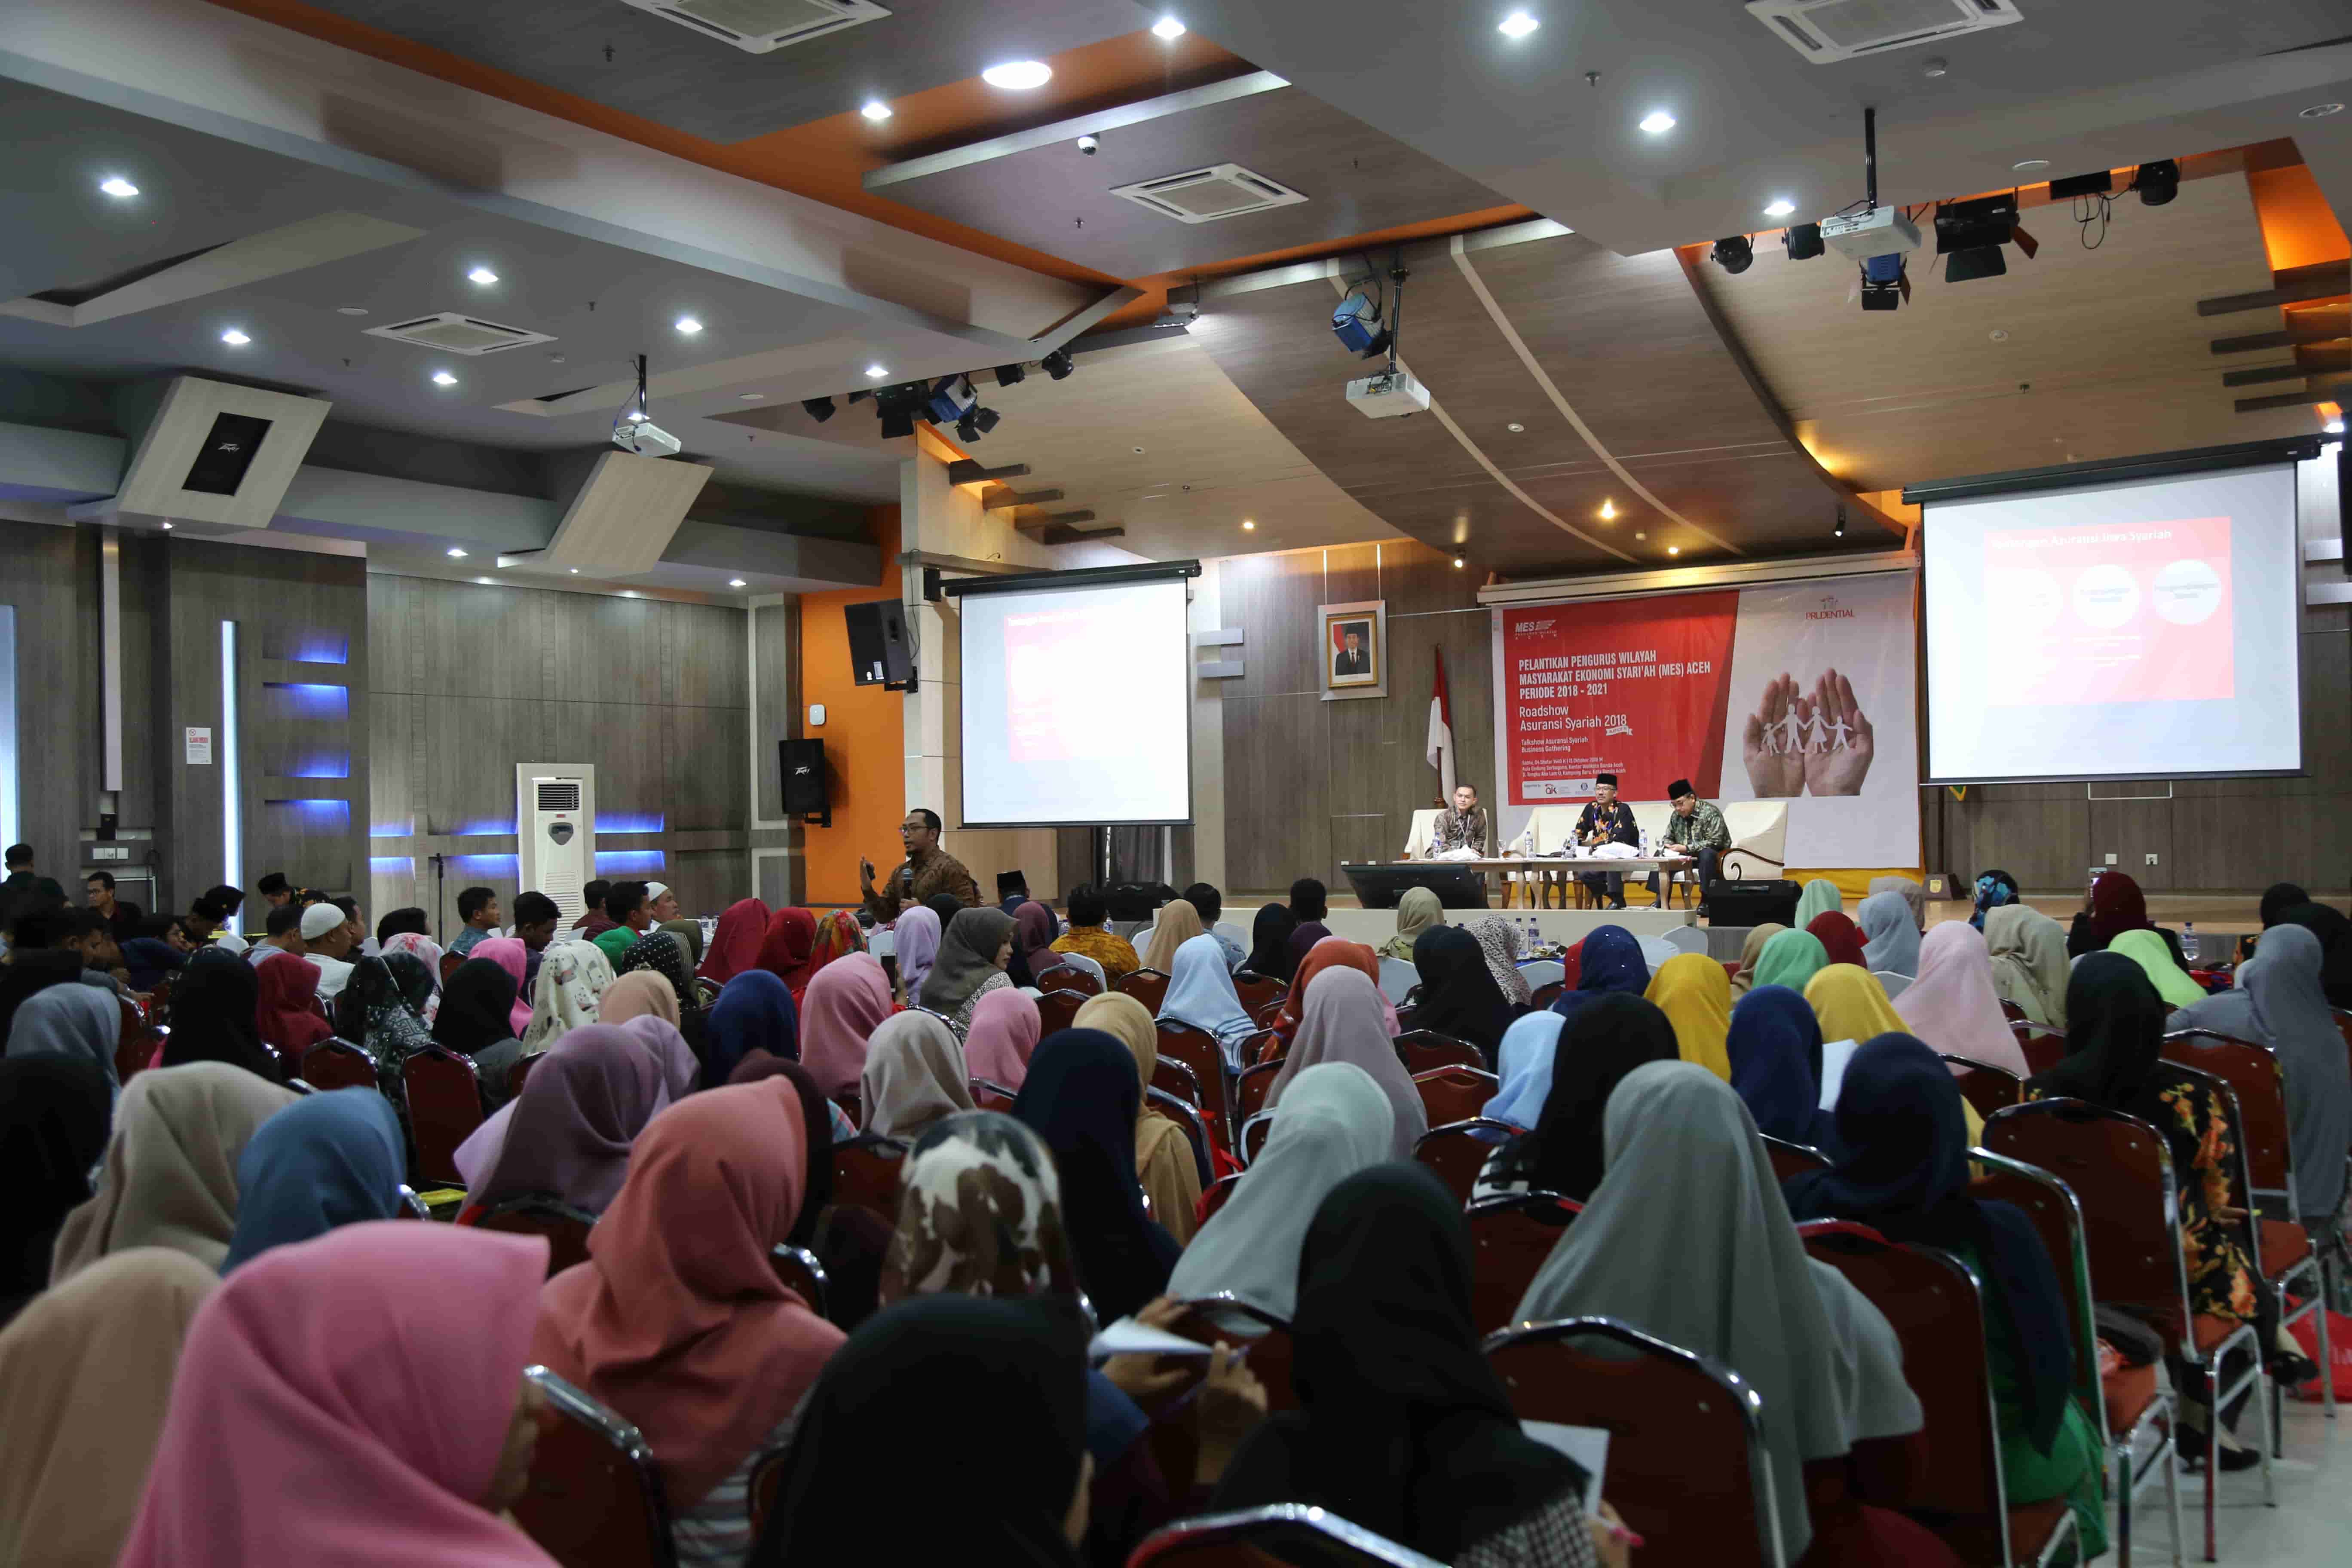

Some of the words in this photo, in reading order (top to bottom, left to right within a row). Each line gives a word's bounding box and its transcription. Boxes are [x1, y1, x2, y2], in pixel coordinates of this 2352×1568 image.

[1805, 609, 1855, 619] PRUDENTIAL
[1516, 622, 1534, 633] MES
[1519, 656, 1568, 671] PELANTIKAN
[1571, 653, 1616, 667] PENGURUS
[1619, 650, 1656, 664] WILAYAH
[1519, 671, 1573, 685] MASYARAKAT
[1575, 667, 1614, 681] EKONOMI
[1617, 665, 1656, 679] SYARI'AH
[1659, 663, 1684, 679] (MES)
[1687, 661, 1711, 674] ACEH
[1520, 686, 1555, 700] PERIODE
[1557, 685, 1578, 697] 2018
[1587, 683, 1607, 695] 2021
[1519, 705, 1568, 718] Roadshow
[1520, 718, 1562, 731] Asuransi
[1565, 716, 1601, 731] Syariah
[1605, 714, 1627, 726] 2018
[1569, 736, 1588, 745] Syariah
